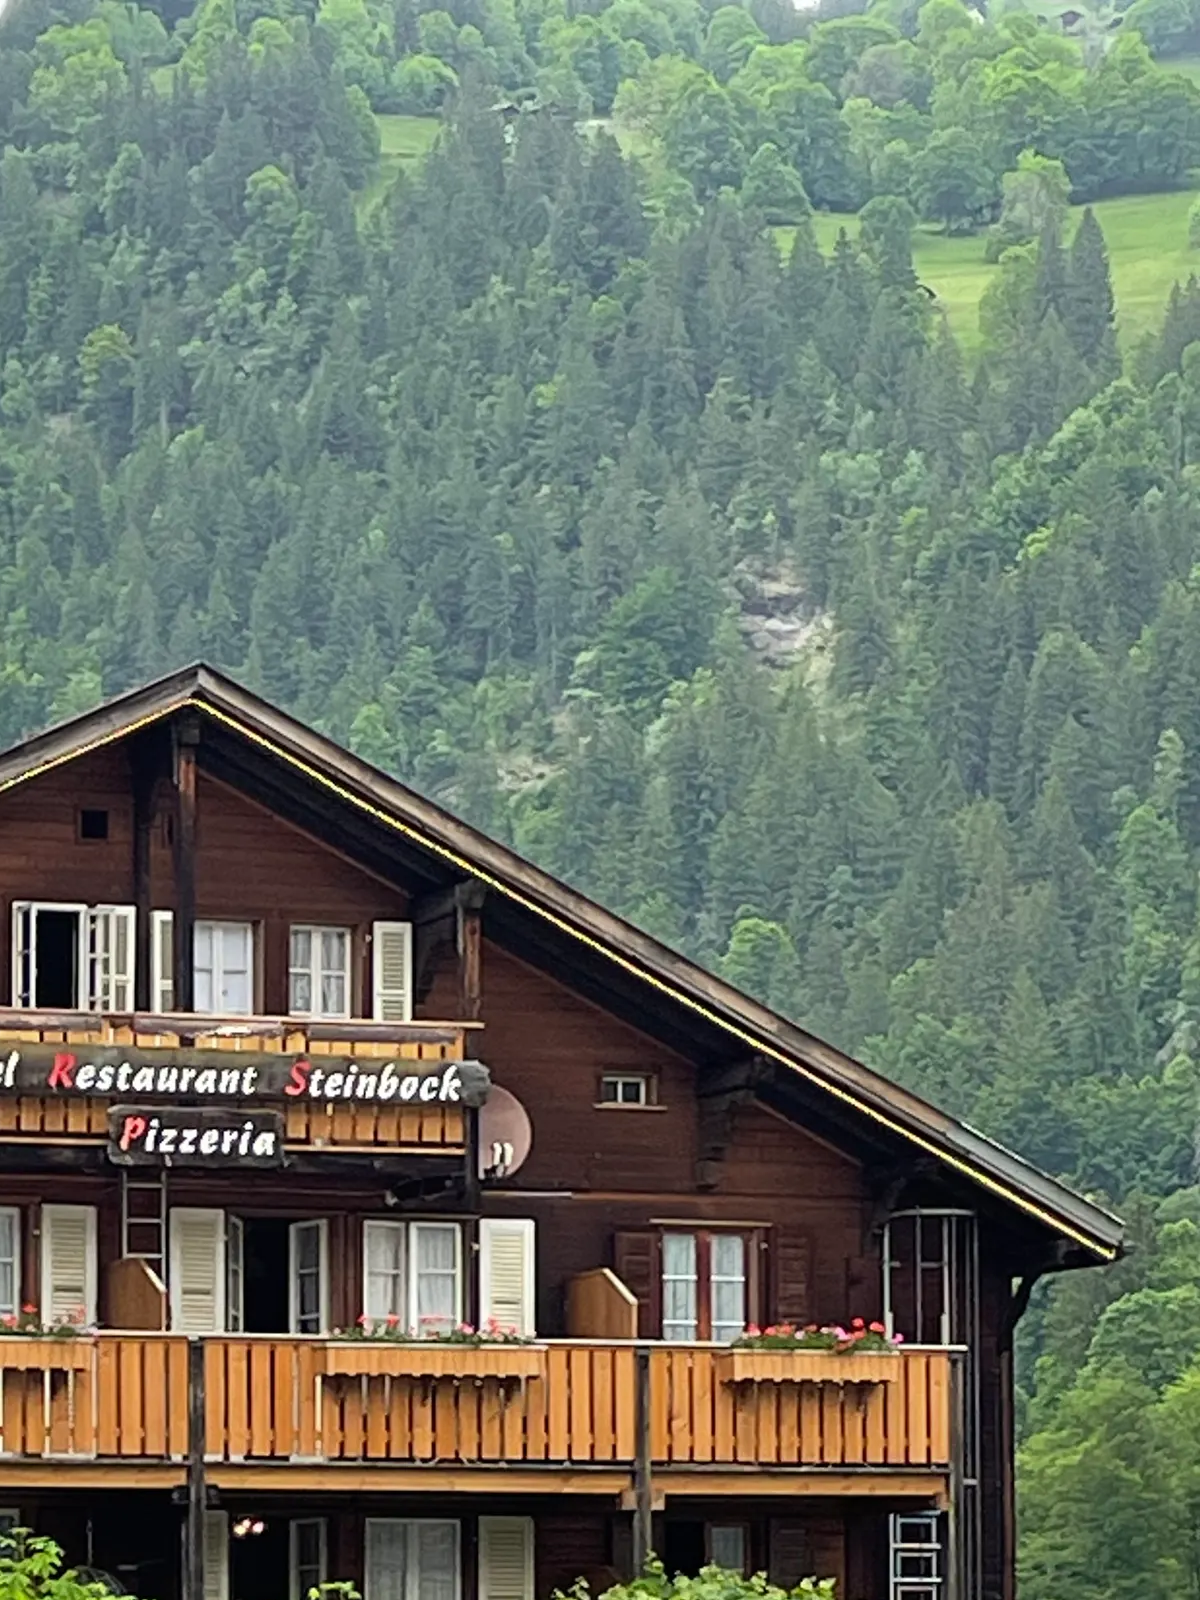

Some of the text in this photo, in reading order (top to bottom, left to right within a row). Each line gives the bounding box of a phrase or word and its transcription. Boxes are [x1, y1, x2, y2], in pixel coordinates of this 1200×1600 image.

[48, 1052, 258, 1096] Restaurant
[285, 1060, 463, 1102] Steinbock
[119, 1116, 276, 1158] Pizzeria
